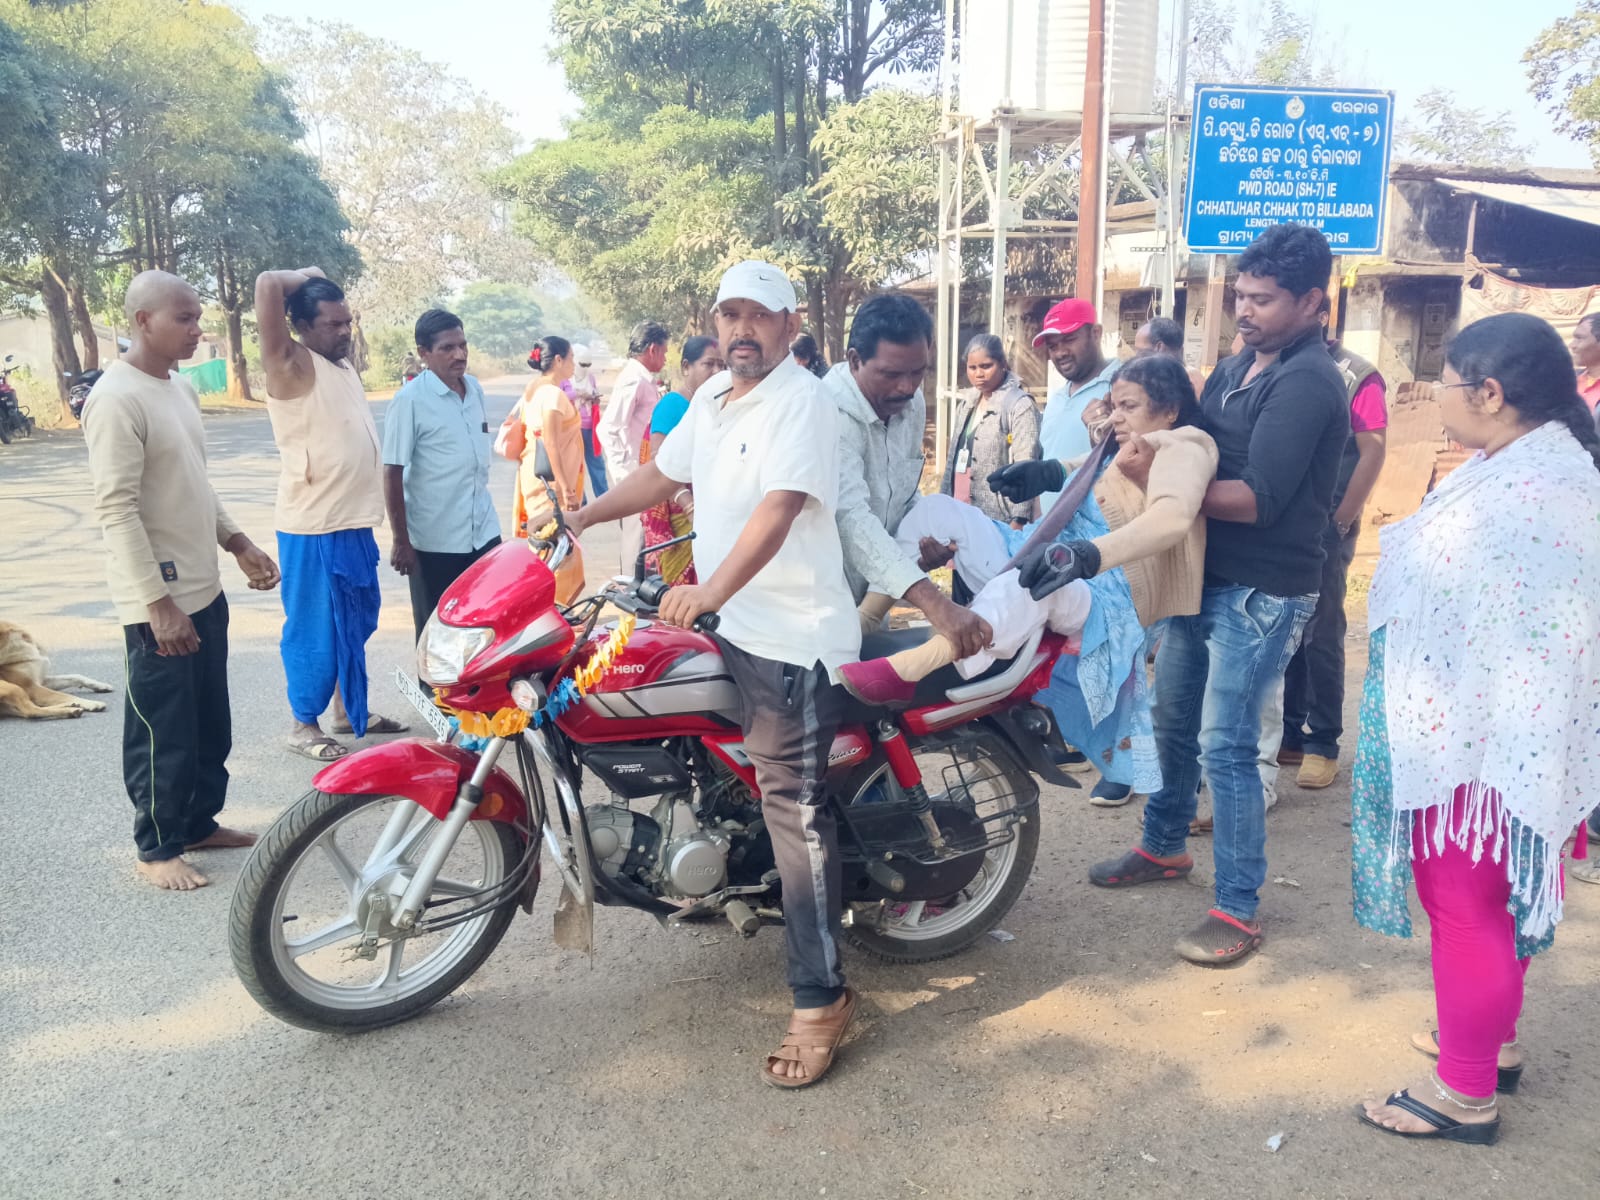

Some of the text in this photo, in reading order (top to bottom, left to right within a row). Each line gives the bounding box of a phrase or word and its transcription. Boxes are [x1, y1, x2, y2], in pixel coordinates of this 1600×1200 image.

[1332, 102, 1378, 114] ସରକାର
[1238, 180, 1337, 200] PWD ROAD (SH-7) IE
[1196, 200, 1374, 218] CHHATIJHAR CHHAK TO BILLABADA
[613, 664, 645, 674] Hero
